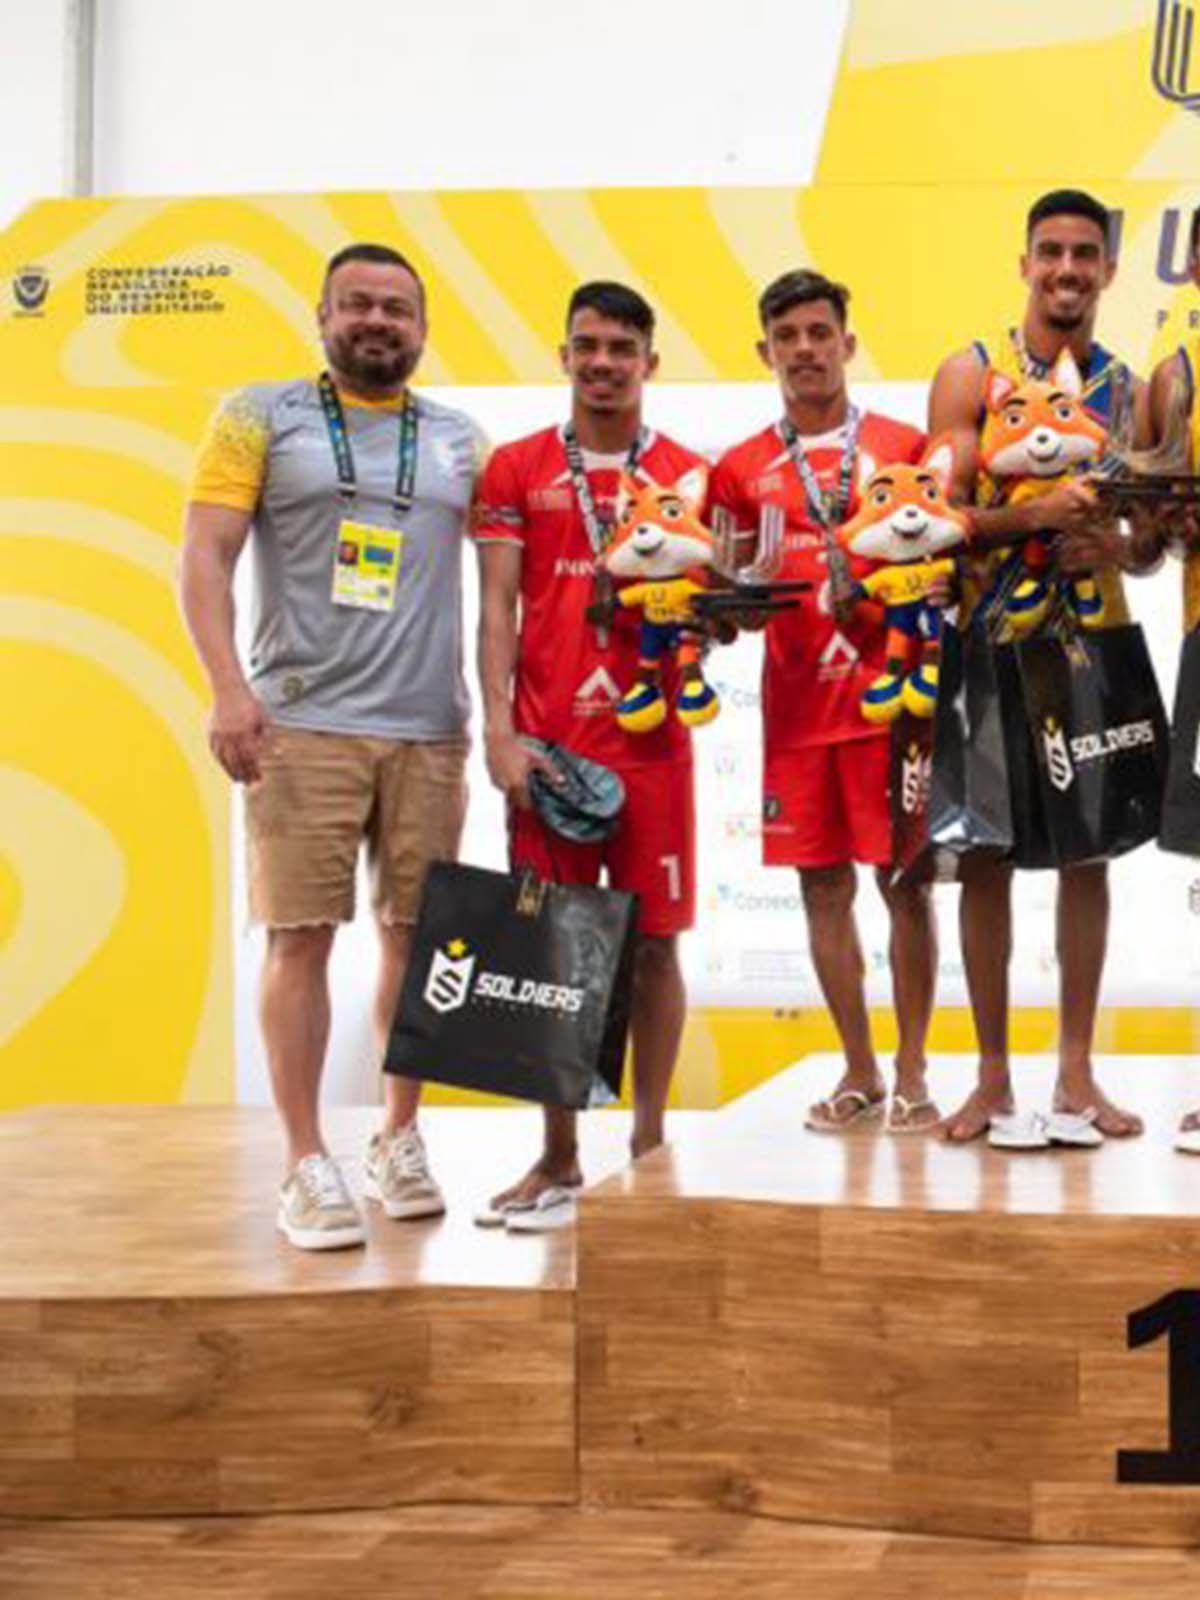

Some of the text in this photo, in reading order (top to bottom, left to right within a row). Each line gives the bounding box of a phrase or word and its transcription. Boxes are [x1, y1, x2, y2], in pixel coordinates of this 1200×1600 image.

[1070, 719, 1155, 763] SOLDIERS
[659, 855, 682, 901] 1
[473, 972, 586, 1013] SOLDIERS
